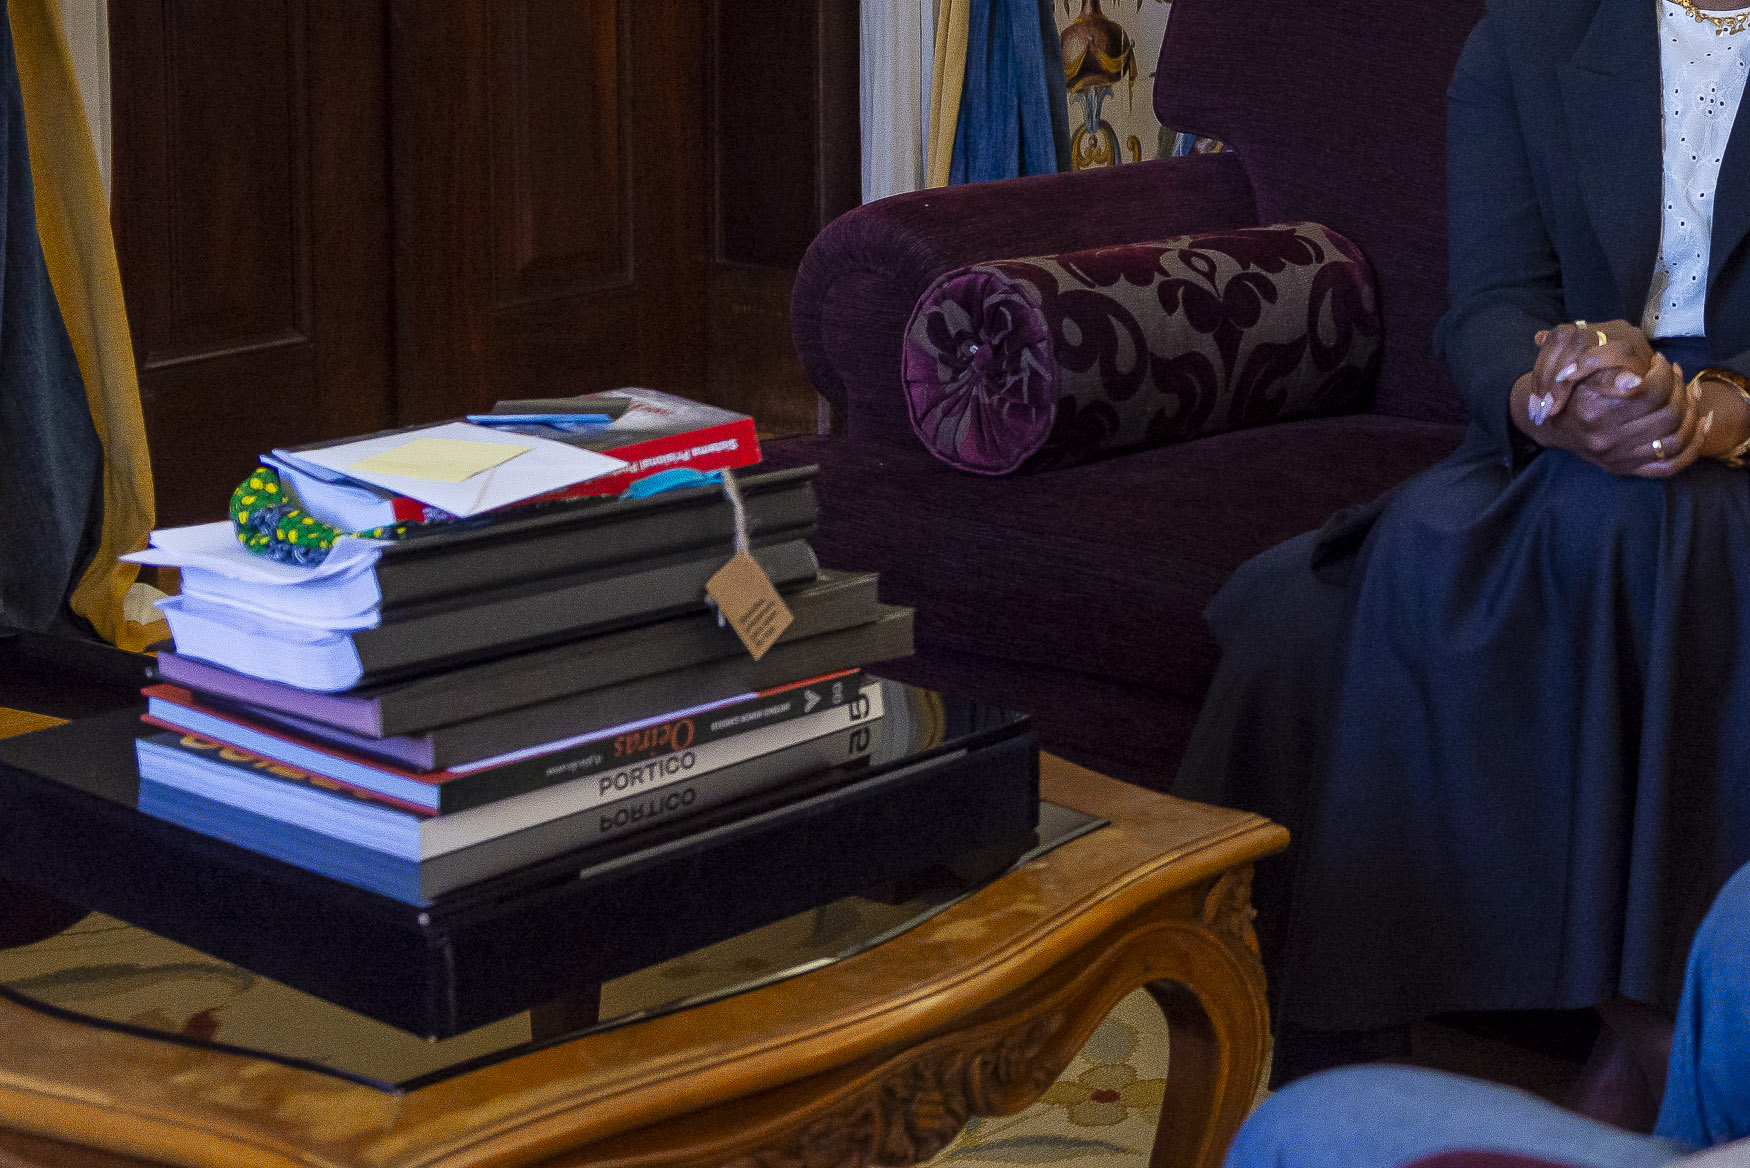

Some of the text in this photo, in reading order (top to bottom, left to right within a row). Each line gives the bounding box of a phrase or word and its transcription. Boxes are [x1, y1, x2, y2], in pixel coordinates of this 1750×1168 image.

[640, 438, 739, 470] Sistema Prisional
[614, 717, 696, 758] Oeiras
[598, 750, 697, 797] PORTICO
